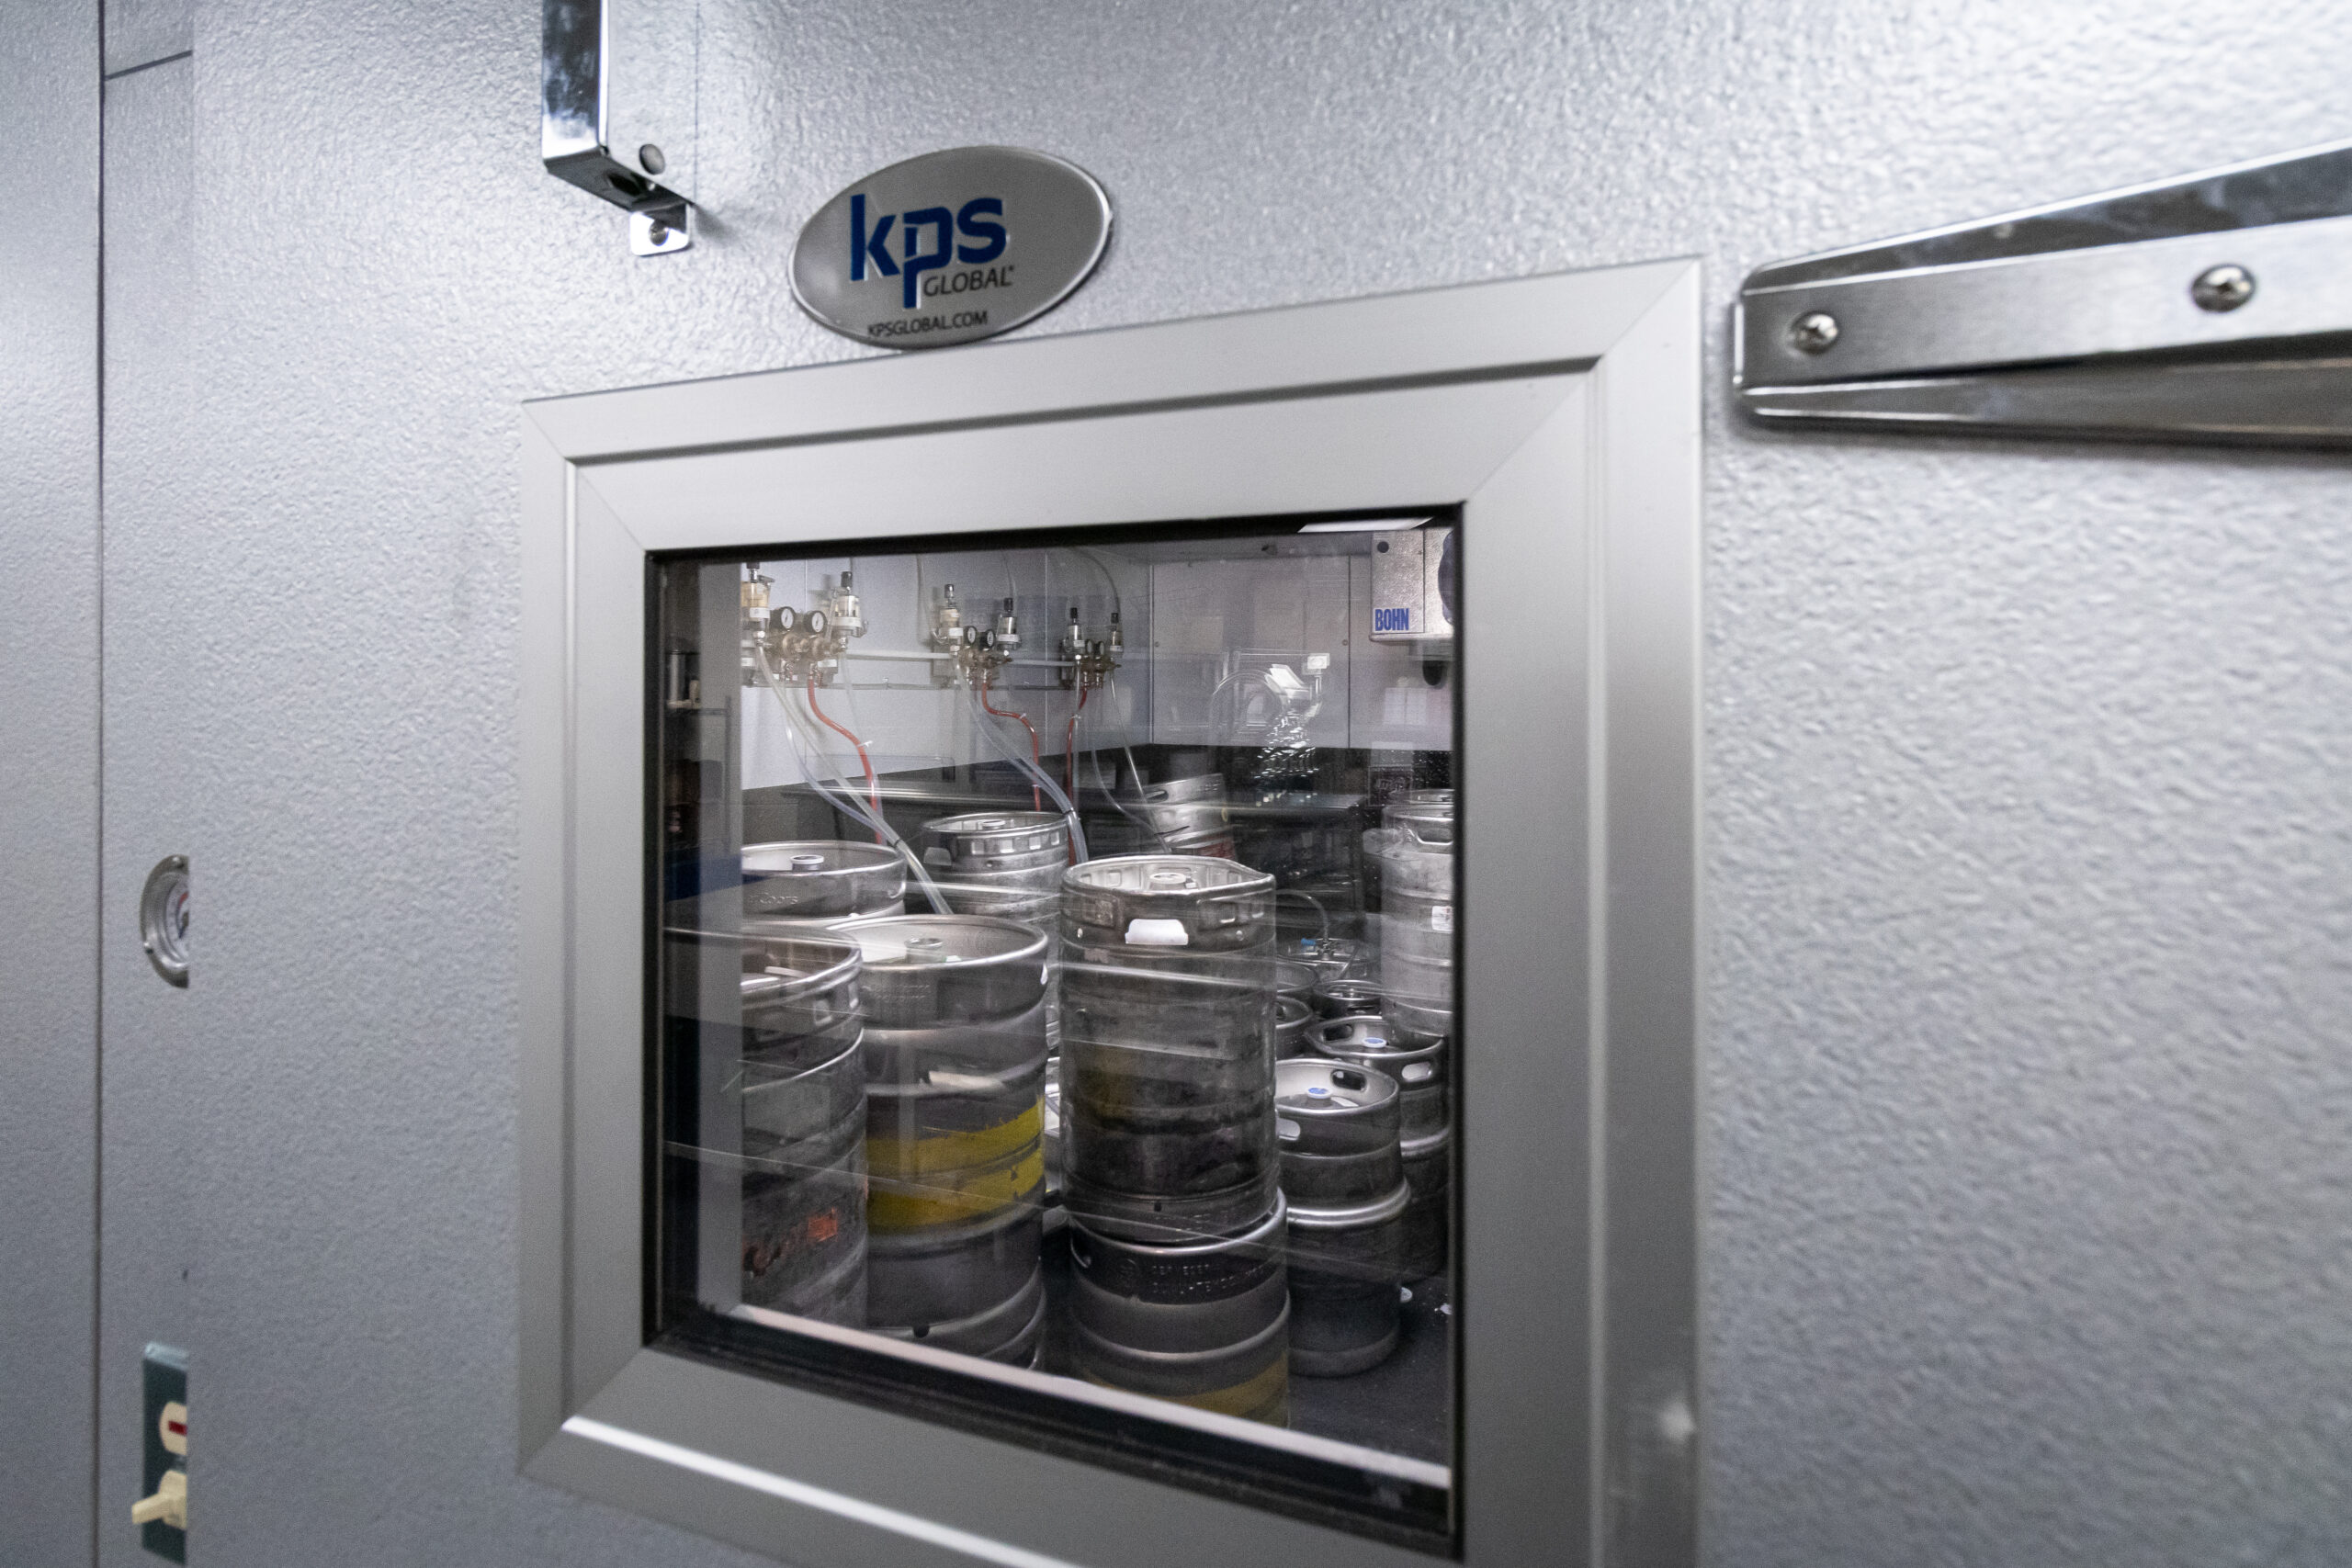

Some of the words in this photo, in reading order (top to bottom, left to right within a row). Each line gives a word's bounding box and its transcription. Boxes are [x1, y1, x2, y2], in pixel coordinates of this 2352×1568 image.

[851, 194, 1006, 309] kps
[923, 266, 1012, 297] GLOBAL
[867, 310, 988, 337] KPSGLOBAL.COM
[1374, 608, 1409, 631] BOHN
